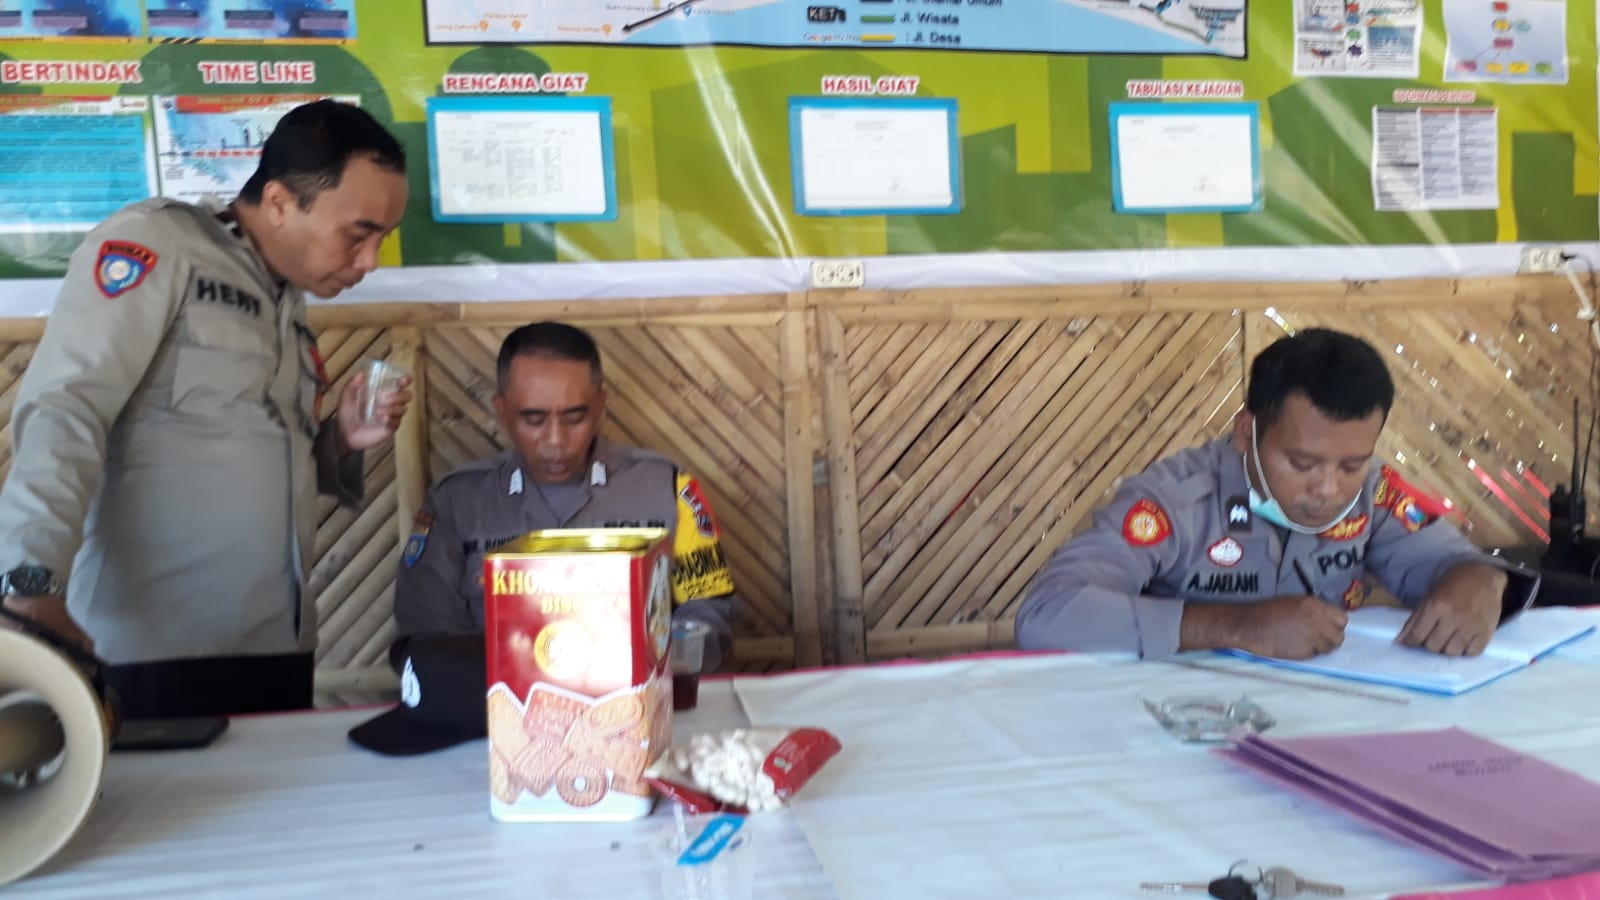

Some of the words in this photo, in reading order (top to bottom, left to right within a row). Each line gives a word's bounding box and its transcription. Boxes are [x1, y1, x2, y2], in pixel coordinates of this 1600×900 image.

[918, 13, 959, 25] Wisata
[930, 32, 961, 44] Desa
[1, 62, 142, 82] BERTINDAK
[201, 62, 258, 82] TIME
[262, 62, 315, 82] LINE
[445, 75, 539, 91] RENCANA
[541, 75, 587, 91] GIAT
[823, 78, 875, 93] HASIL
[878, 78, 918, 93] GIAT
[1128, 82, 1184, 96] TABULASI
[1318, 546, 1367, 574] POL
